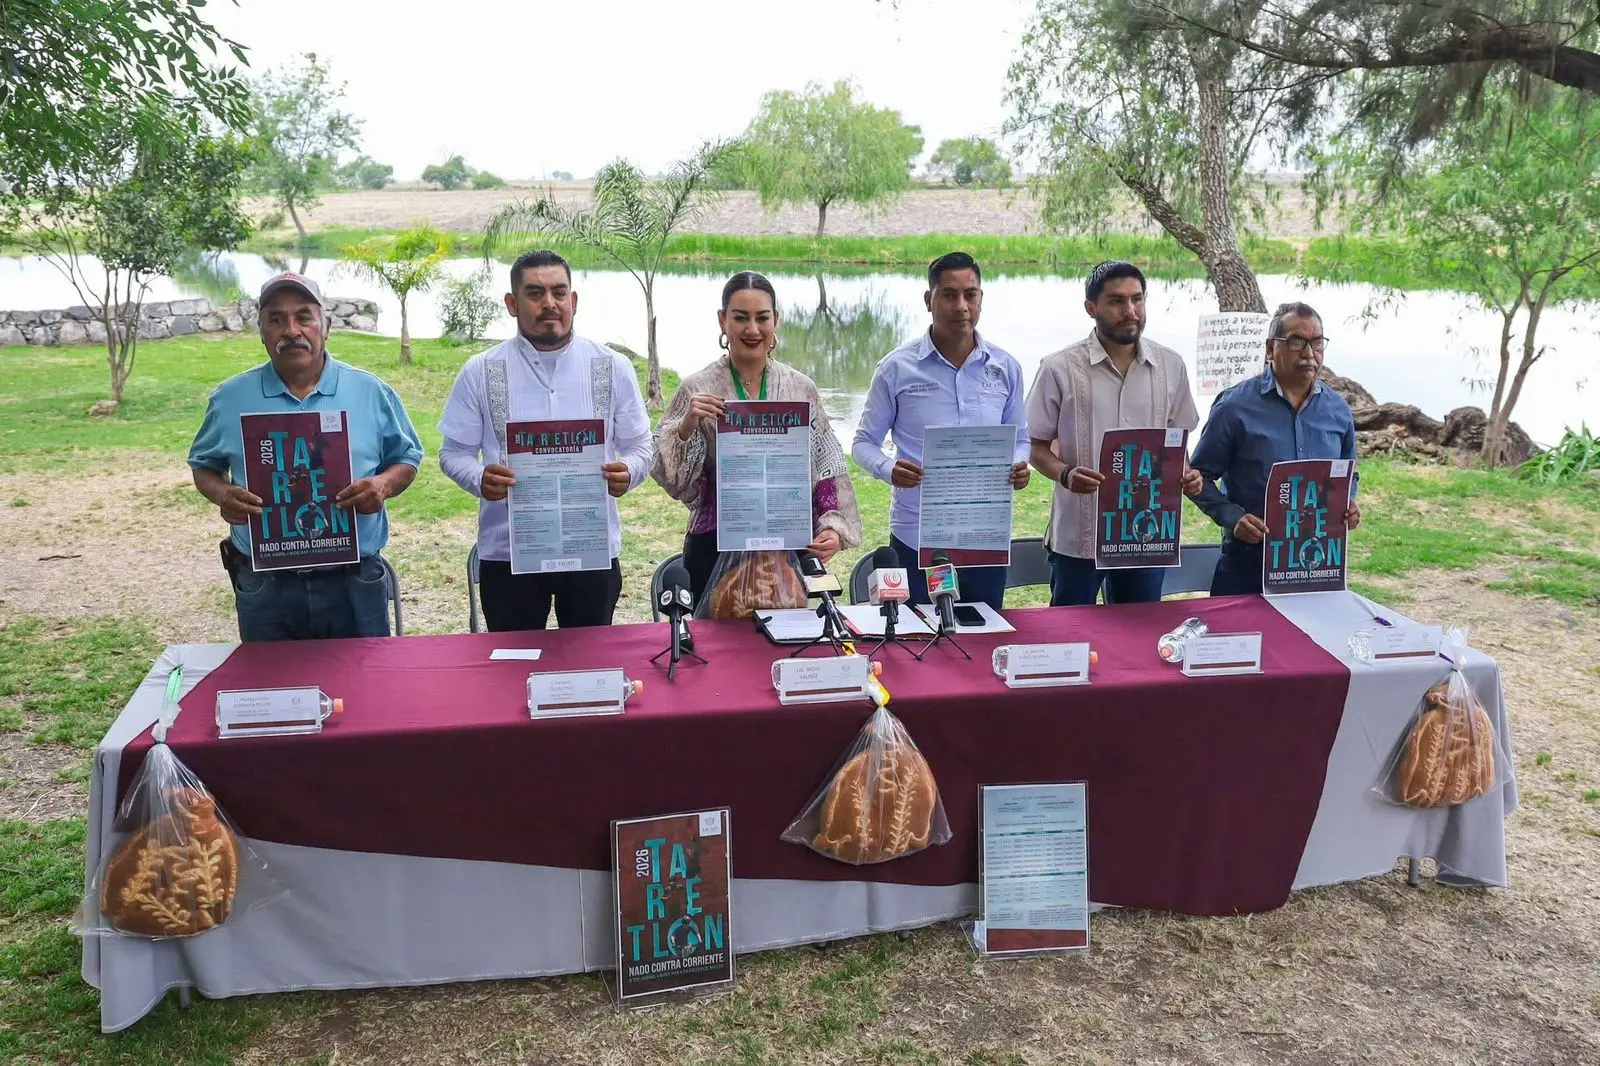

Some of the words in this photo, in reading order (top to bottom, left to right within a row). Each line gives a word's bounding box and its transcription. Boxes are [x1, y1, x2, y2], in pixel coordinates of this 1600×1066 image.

[260, 440, 274, 465] 2026
[1113, 452, 1123, 474] 2026
[1279, 483, 1290, 504] 2026
[259, 542, 280, 552] NADO
[281, 539, 310, 551] CONTRA
[311, 536, 351, 548] CORRIENTE
[1102, 544, 1117, 552] NADO
[1119, 544, 1142, 552] CONTRA
[1143, 543, 1174, 551] CORRIENTE
[1269, 572, 1285, 580] NADO
[1286, 570, 1309, 579] CONTRA
[1309, 569, 1340, 578] CORRIENTE
[636, 849, 649, 877] 2026
[629, 963, 650, 977] NADO
[652, 958, 681, 973] CONTRA
[682, 953, 724, 968] CORRIENTE
